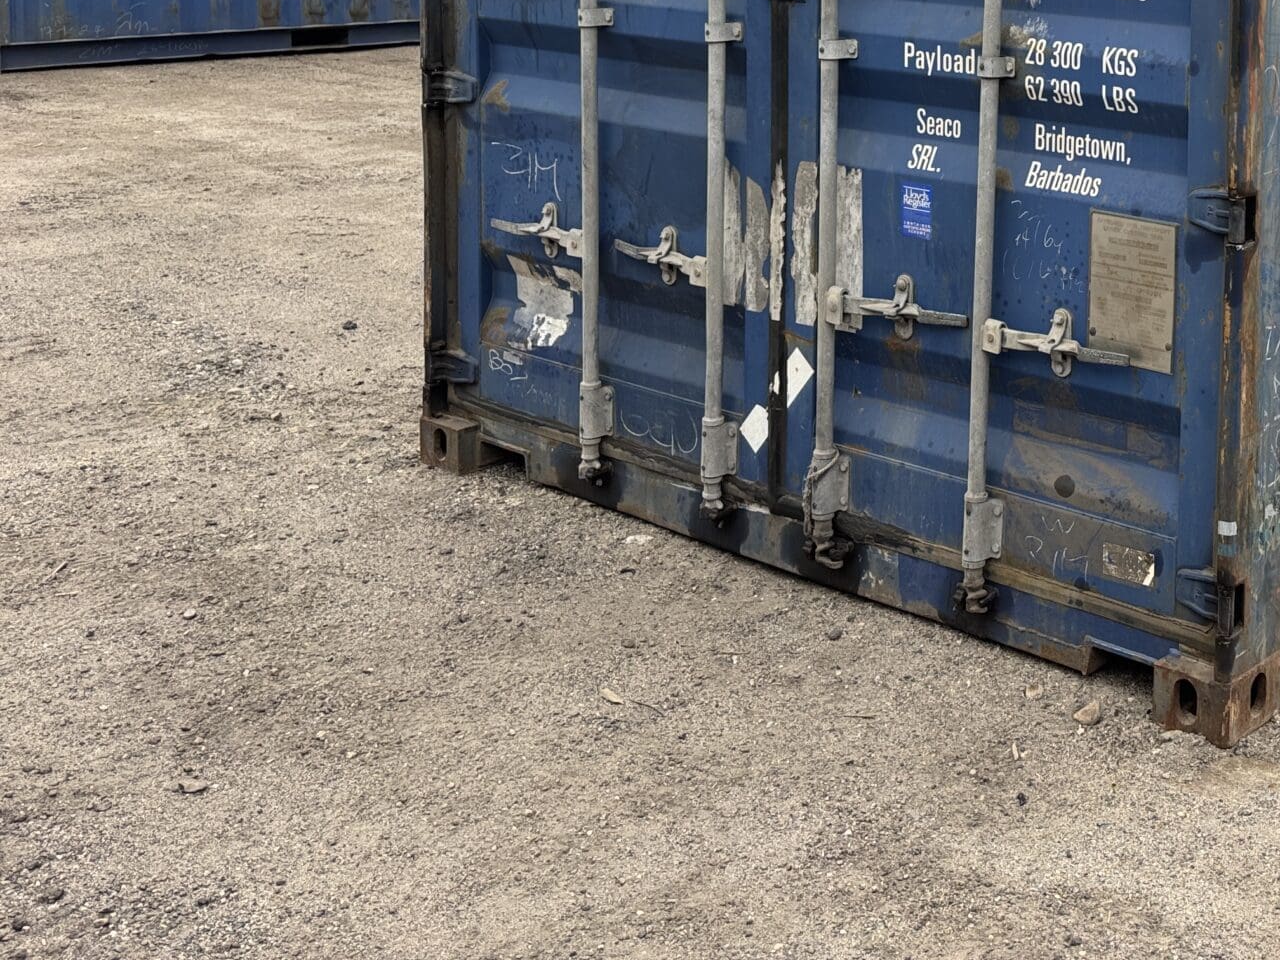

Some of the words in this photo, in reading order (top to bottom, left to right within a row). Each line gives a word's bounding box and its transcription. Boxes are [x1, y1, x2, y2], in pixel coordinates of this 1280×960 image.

[903, 41, 976, 78] Payload
[1024, 37, 1046, 66] 28
[1050, 40, 1084, 70] 300
[1102, 46, 1139, 77] KGS
[1024, 74, 1047, 102] 62
[1050, 77, 1084, 107] 390
[1102, 84, 1139, 114] LBS
[916, 107, 962, 138] Seaco
[907, 143, 942, 173] SRL.
[1034, 123, 1132, 166] Bridgetown,
[1024, 160, 1102, 198] Barbados
